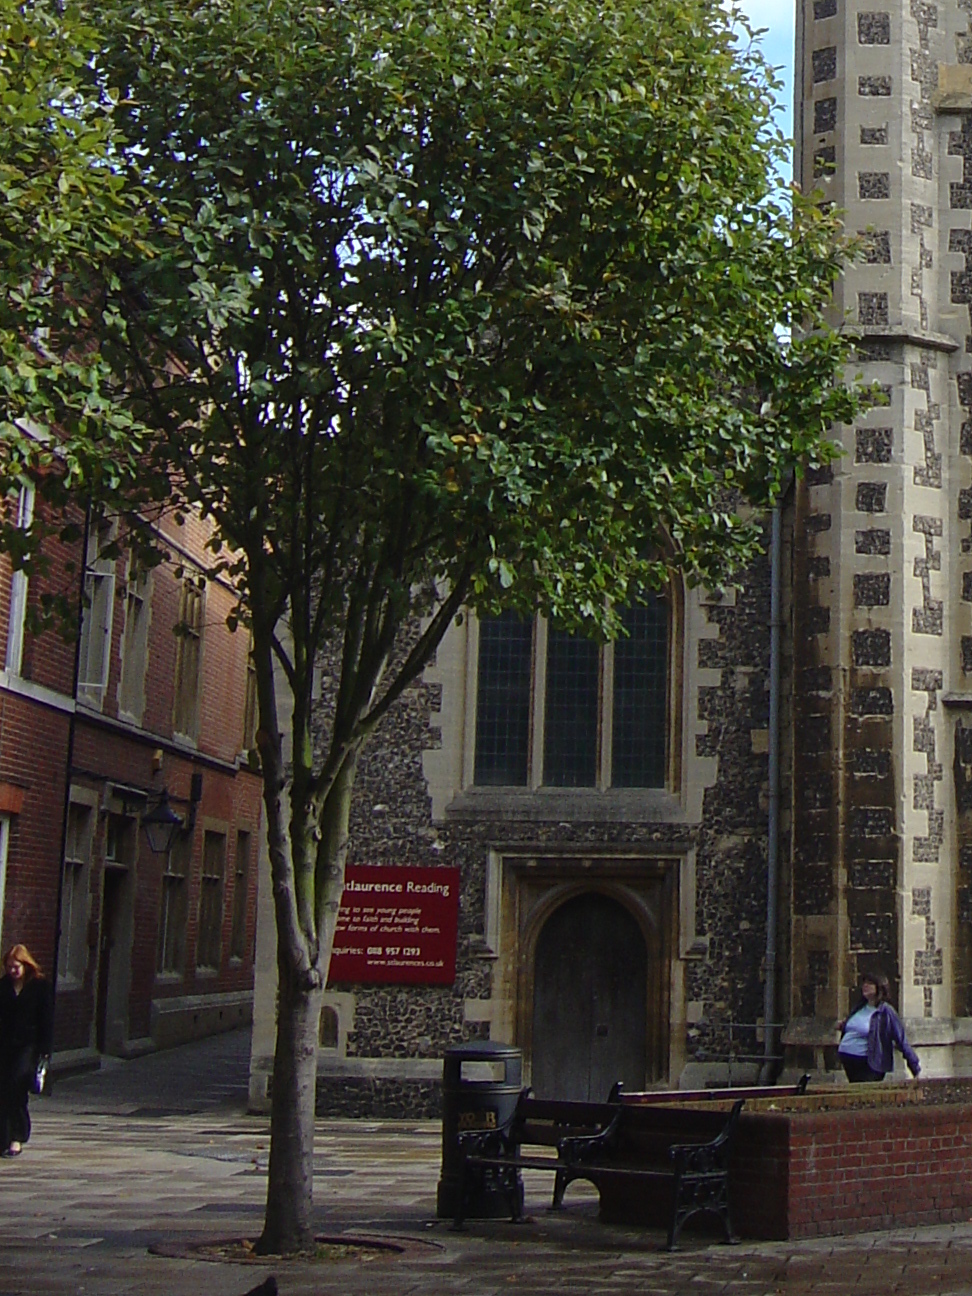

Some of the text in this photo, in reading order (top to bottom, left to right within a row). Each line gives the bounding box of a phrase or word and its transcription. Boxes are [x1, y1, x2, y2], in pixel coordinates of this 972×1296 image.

[344, 880, 449, 897] tlaurence Reading
[398, 907, 421, 915] people
[363, 915, 378, 923] faith
[394, 916, 420, 925] building
[348, 924, 367, 932] forms
[380, 925, 402, 933] church
